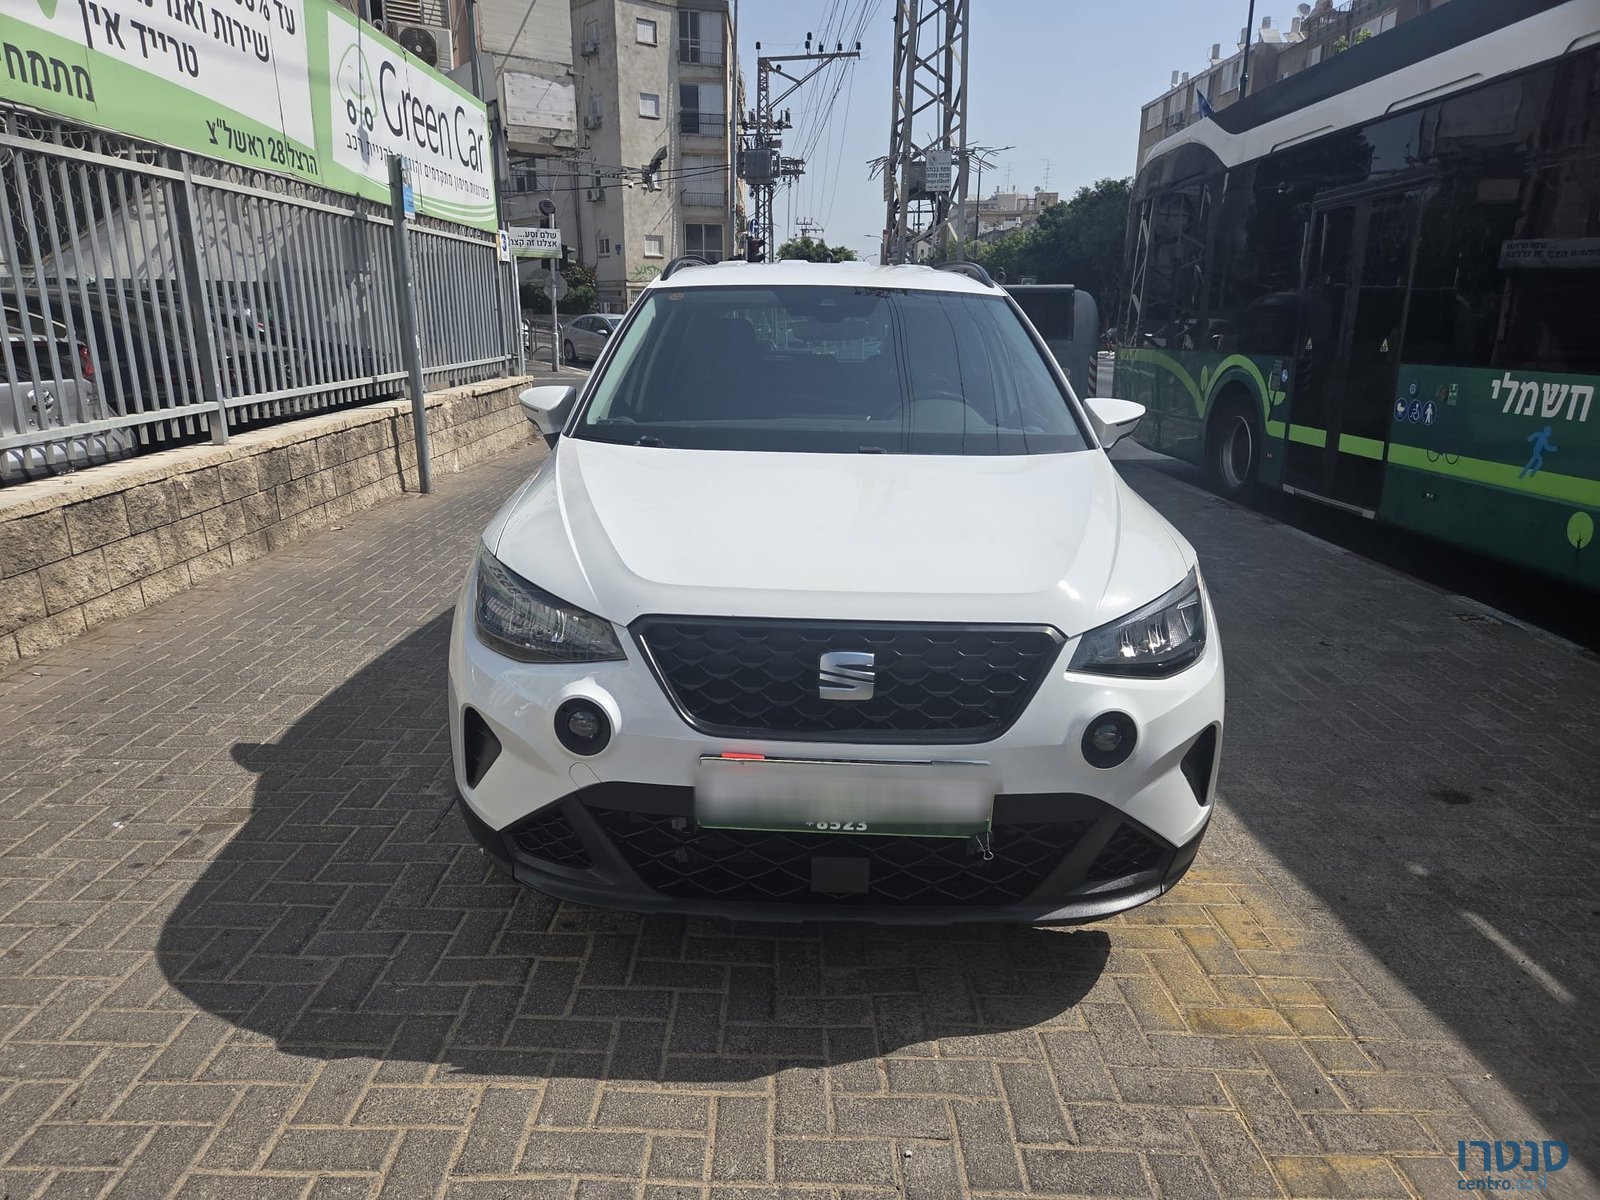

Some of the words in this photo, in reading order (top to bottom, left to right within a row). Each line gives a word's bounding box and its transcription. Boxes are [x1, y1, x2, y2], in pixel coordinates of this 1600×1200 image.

[78, 0, 126, 50] אין
[211, 7, 270, 62] שירות
[273, 0, 295, 35] עד
[0, 42, 95, 102] מתמח
[130, 20, 199, 78] טרייד
[379, 60, 453, 160] Green
[454, 105, 484, 174] Car
[267, 137, 286, 165] 28
[287, 142, 318, 176] הרצל
[536, 239, 558, 248] אצלנו
[540, 230, 557, 239] שלם
[1491, 372, 1595, 422] חשמלי
